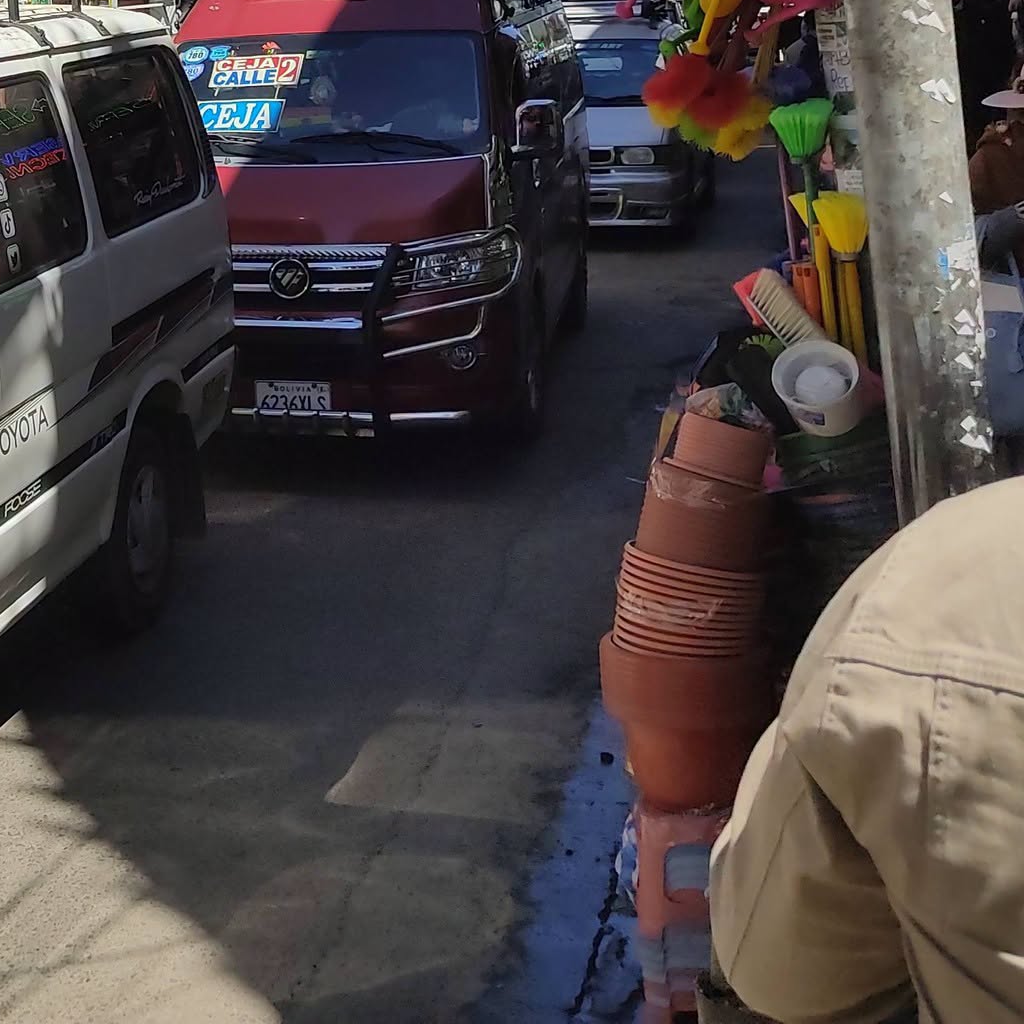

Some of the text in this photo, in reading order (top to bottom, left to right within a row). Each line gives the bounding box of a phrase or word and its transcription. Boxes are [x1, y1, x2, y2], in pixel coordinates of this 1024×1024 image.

[213, 70, 276, 86] CALLE
[216, 58, 298, 83] CEJA 2
[199, 103, 272, 130] CEJA
[3, 479, 42, 518] FOOSE
